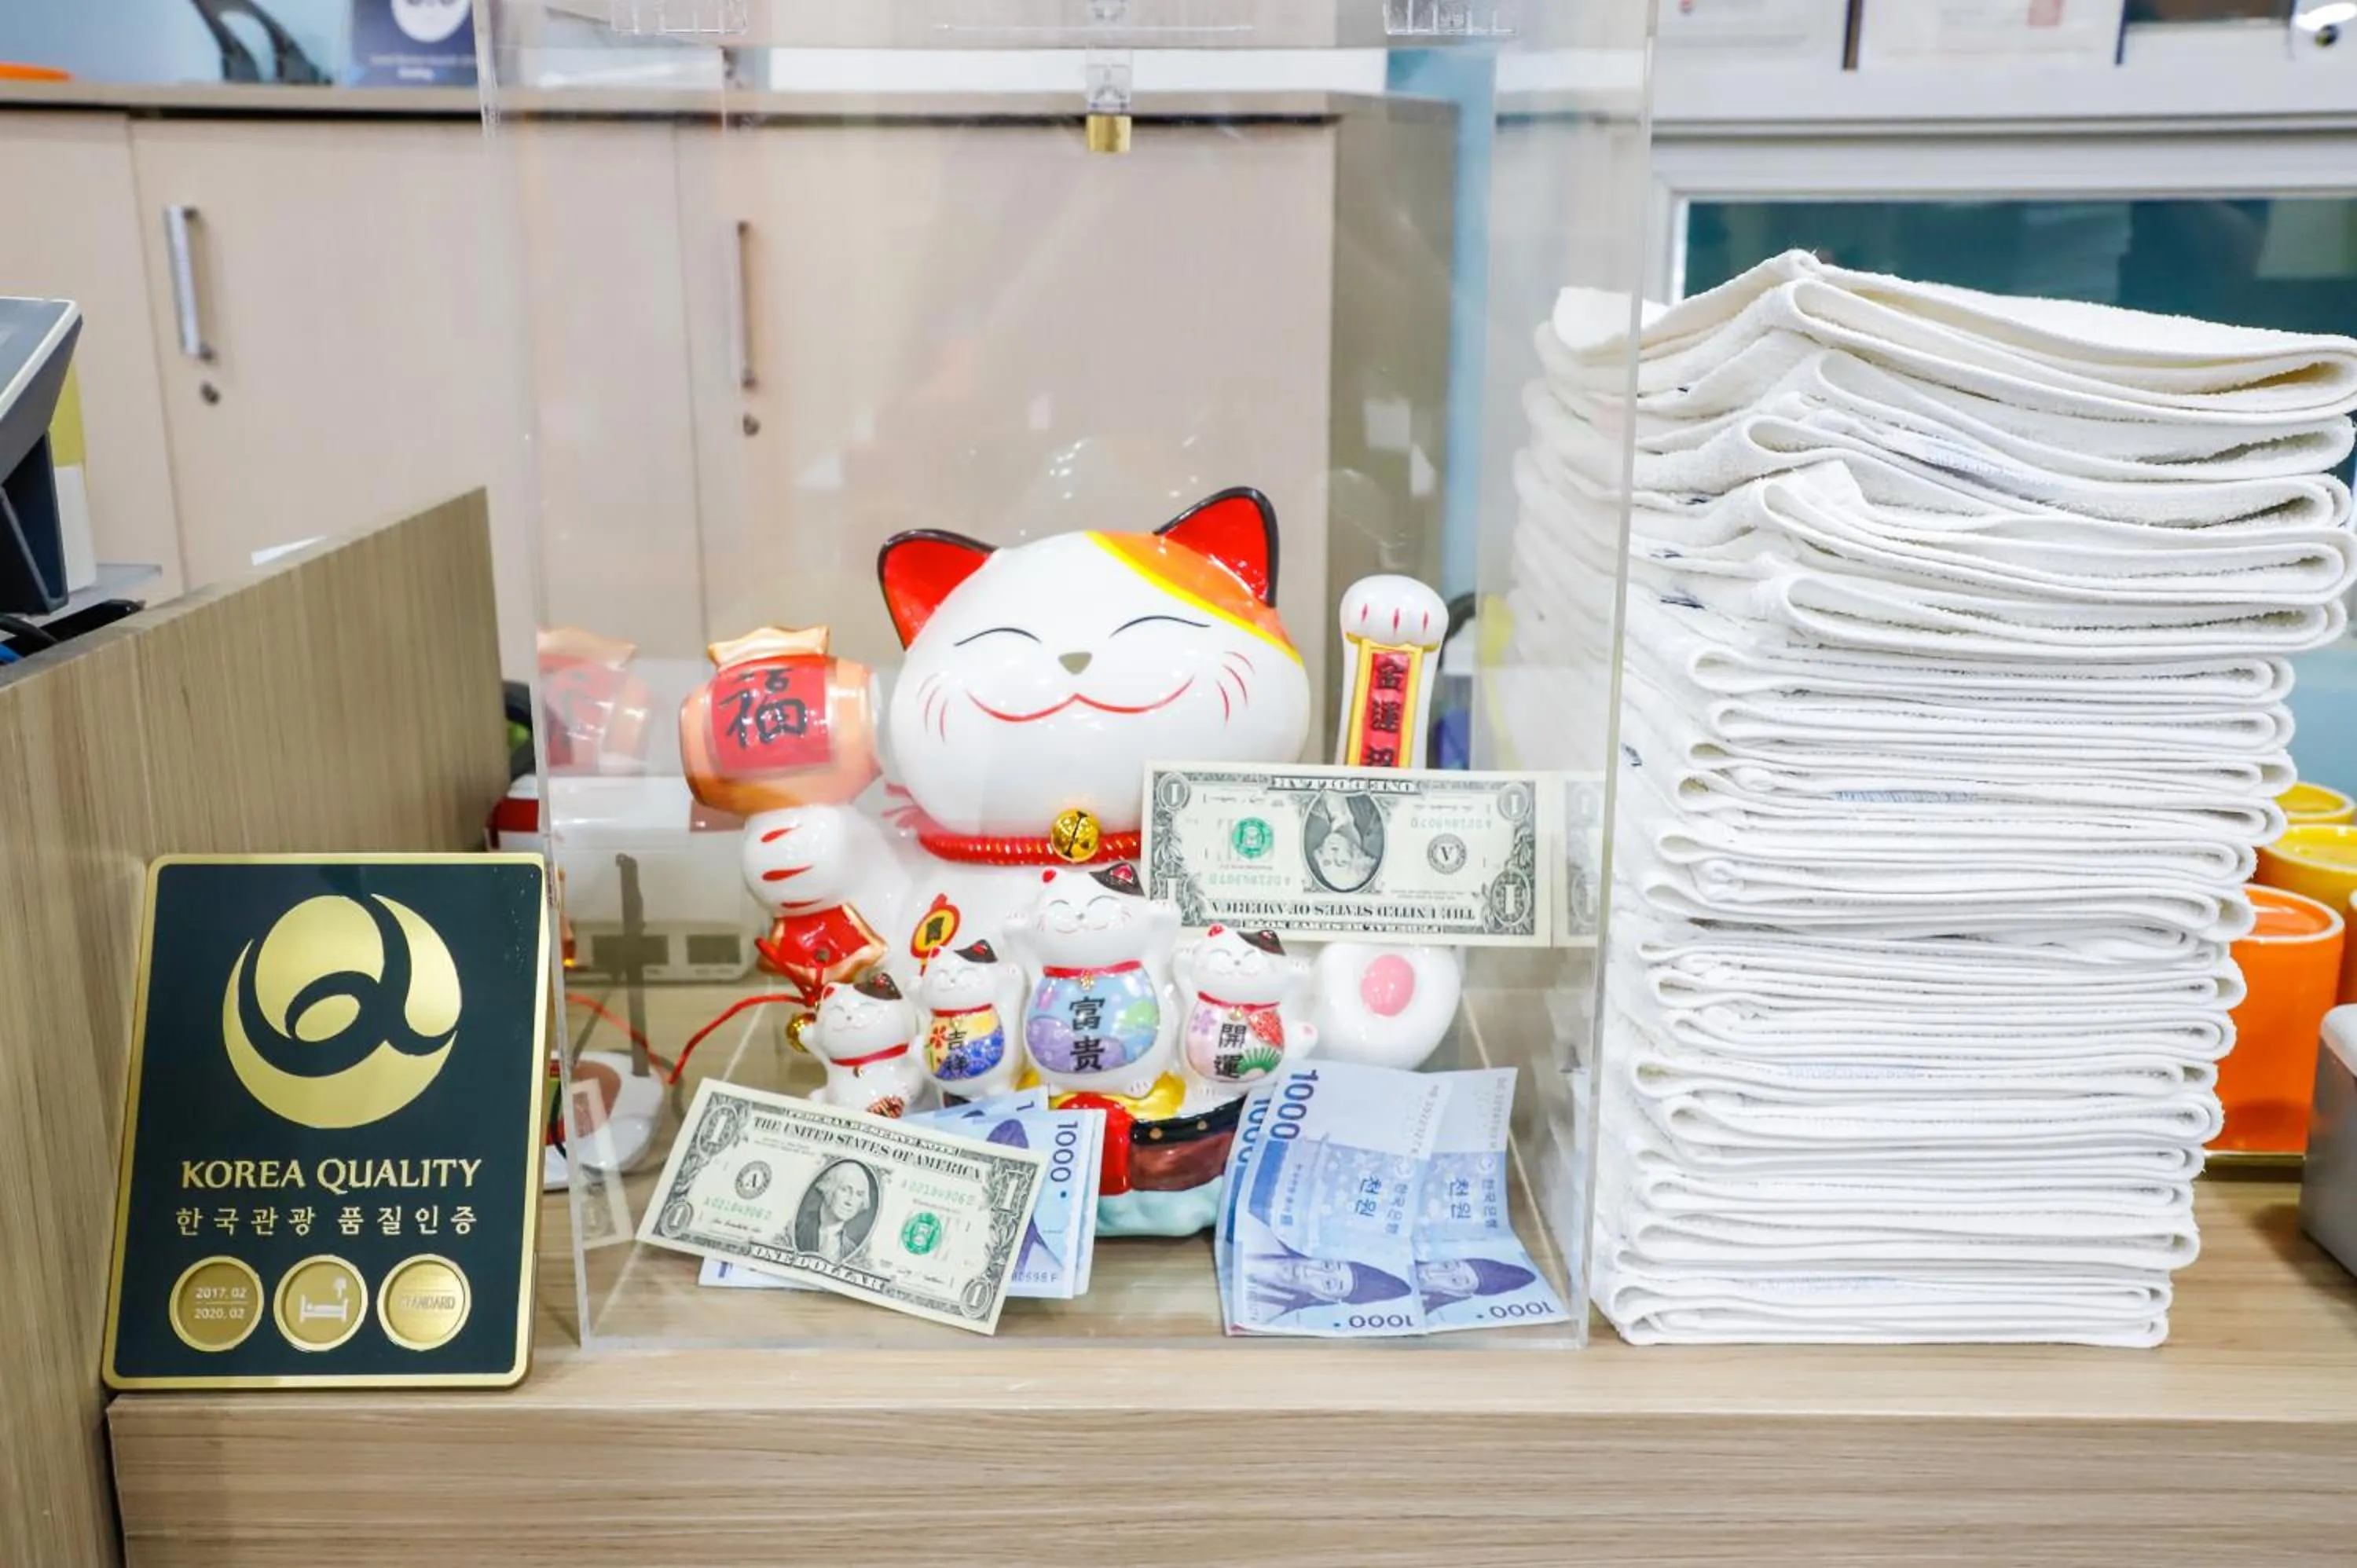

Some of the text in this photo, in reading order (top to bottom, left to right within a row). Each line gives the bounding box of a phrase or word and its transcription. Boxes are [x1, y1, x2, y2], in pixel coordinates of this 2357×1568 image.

[720, 669, 808, 749] 福
[1273, 777, 1368, 792] DOLLAR
[1211, 902, 1476, 921] THE UNITED STATES OF AMERICA
[1269, 1069, 1319, 1140] 1000
[753, 1116, 780, 1133] THE
[783, 1122, 834, 1143] UNITED
[836, 1134, 889, 1157] STATES
[892, 1148, 915, 1163] OF
[915, 1152, 982, 1180] AMERICA
[1050, 1120, 1079, 1183] 1000
[181, 1157, 482, 1196] KOREA QUALITY
[175, 1205, 478, 1236] 한국관광 품질인증
[751, 1244, 793, 1265] ONE
[793, 1255, 885, 1291] DOLLAR
[1348, 1314, 1415, 1329] 1000
[1490, 1300, 1555, 1319] 1000
